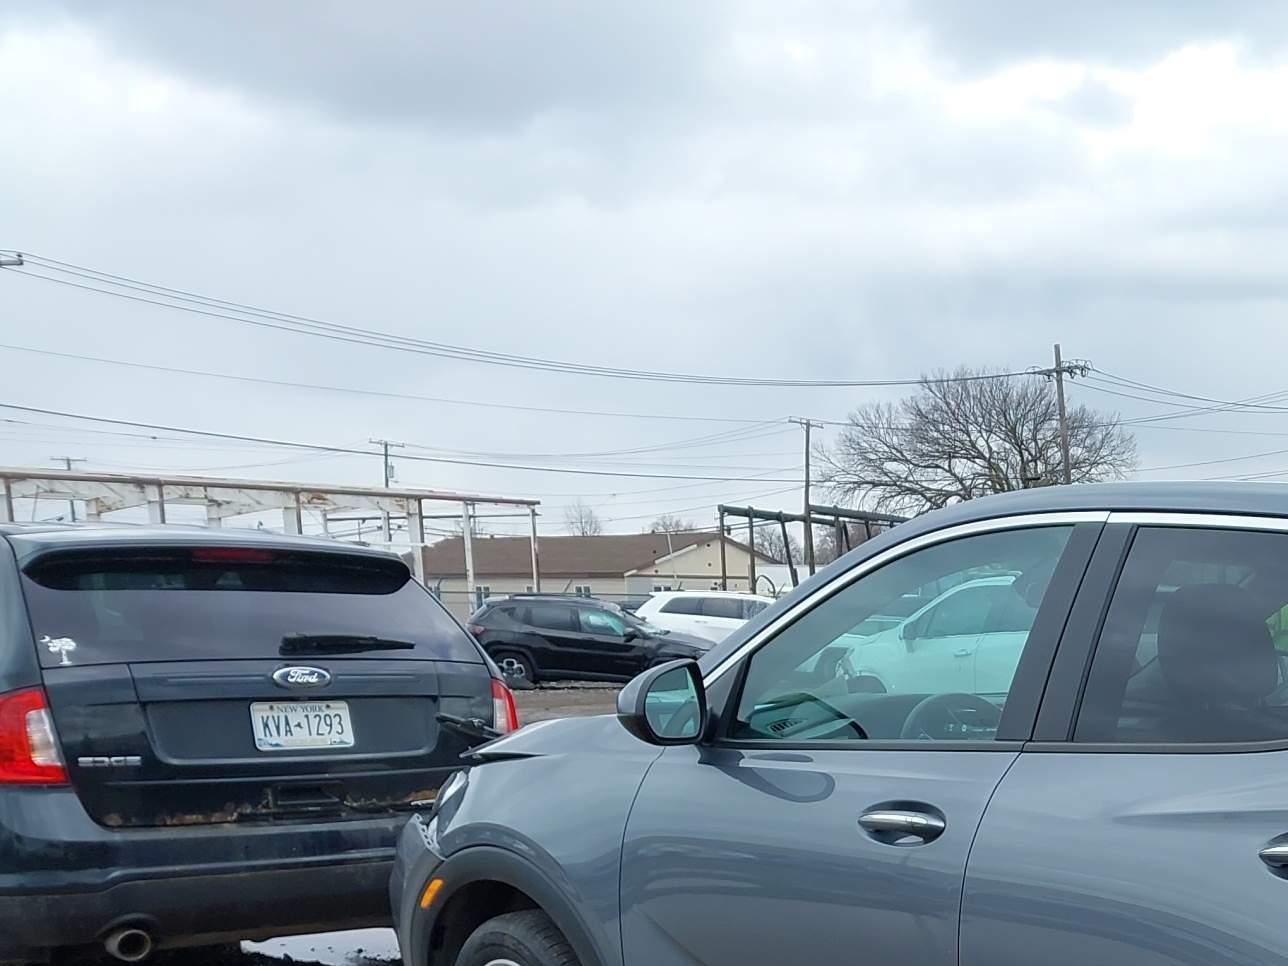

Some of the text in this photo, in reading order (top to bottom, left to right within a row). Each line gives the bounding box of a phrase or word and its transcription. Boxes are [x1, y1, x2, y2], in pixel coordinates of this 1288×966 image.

[287, 669, 320, 683] Ford
[277, 704, 324, 713] NEW YORK
[78, 756, 142, 767] EDGE
